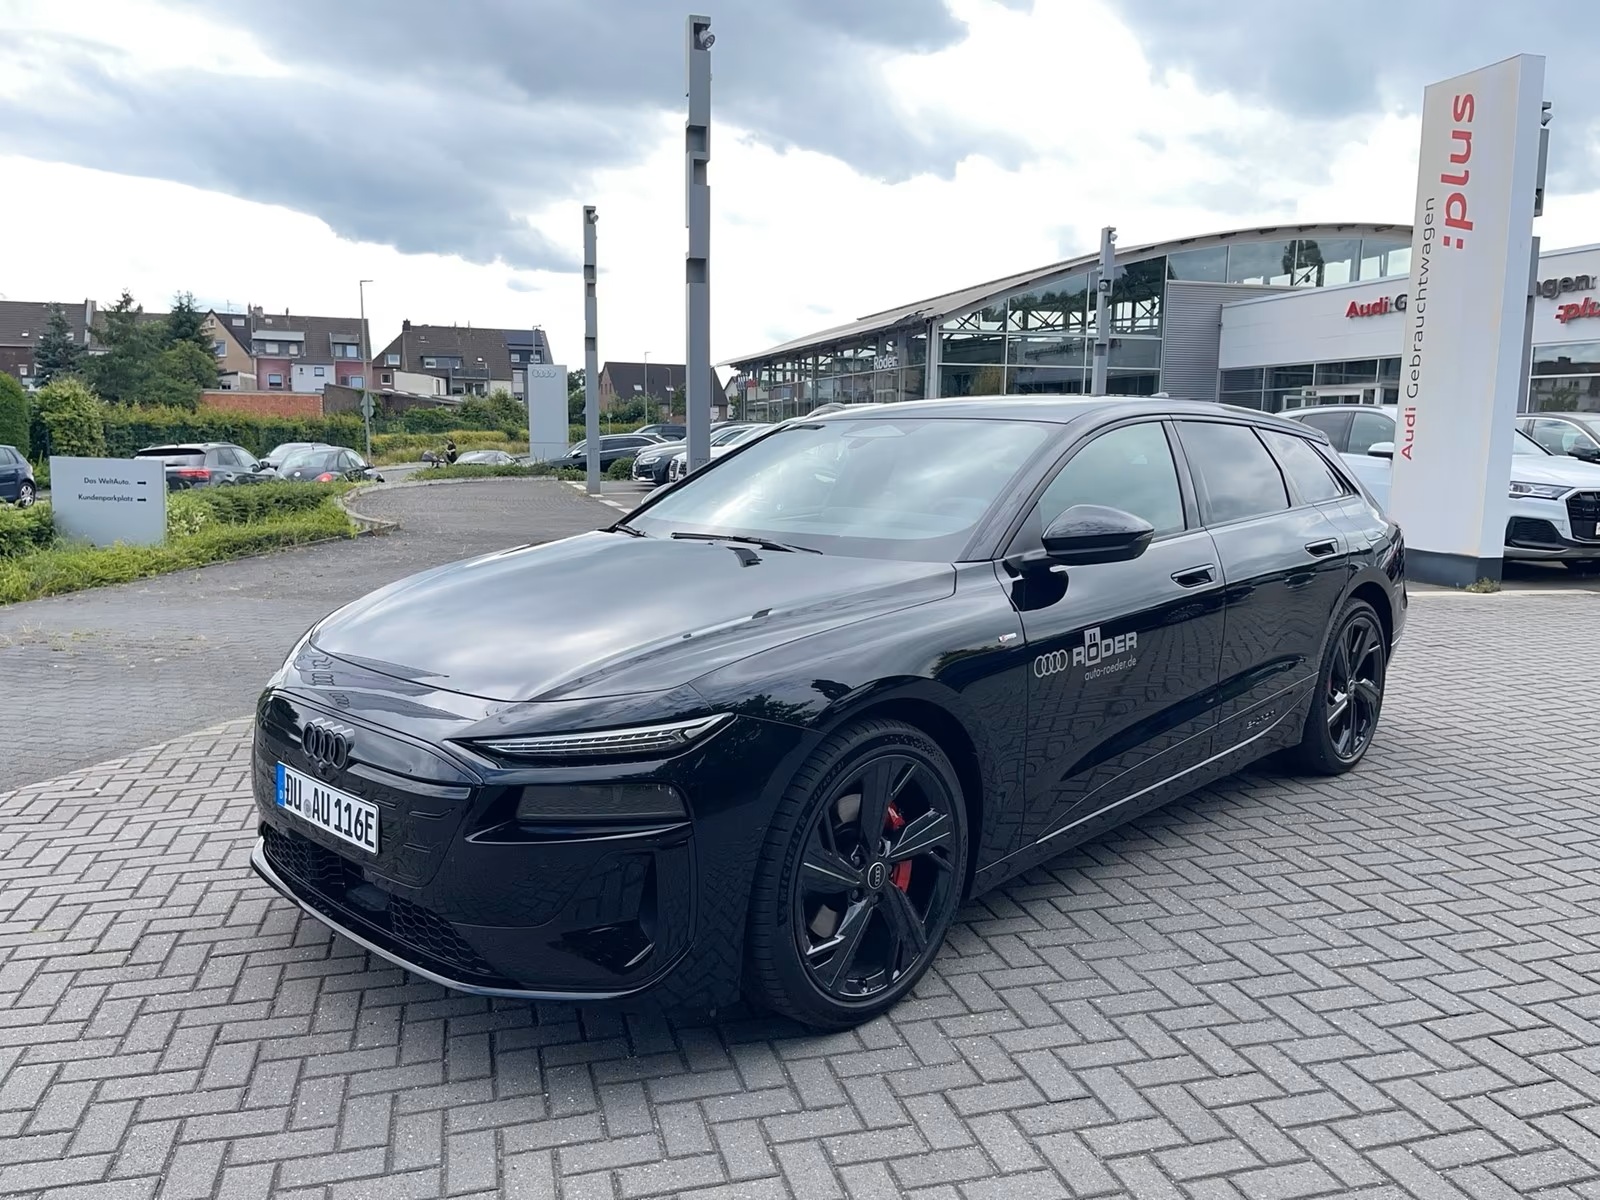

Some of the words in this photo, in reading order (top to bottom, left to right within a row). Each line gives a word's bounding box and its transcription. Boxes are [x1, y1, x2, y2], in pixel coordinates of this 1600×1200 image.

[1440, 93, 1475, 250] :plus
[1345, 296, 1390, 318] Audi
[1407, 197, 1435, 399] Gebrauchtwagen
[873, 354, 898, 370] Röder
[1401, 406, 1417, 461] Audi
[78, 493, 133, 503] Kundenparkplatz
[1073, 627, 1137, 667] RÖDER
[1084, 654, 1137, 681] auto-roeder.de
[285, 773, 302, 811] DU
[312, 787, 330, 827] AU
[334, 798, 375, 848] 116E
